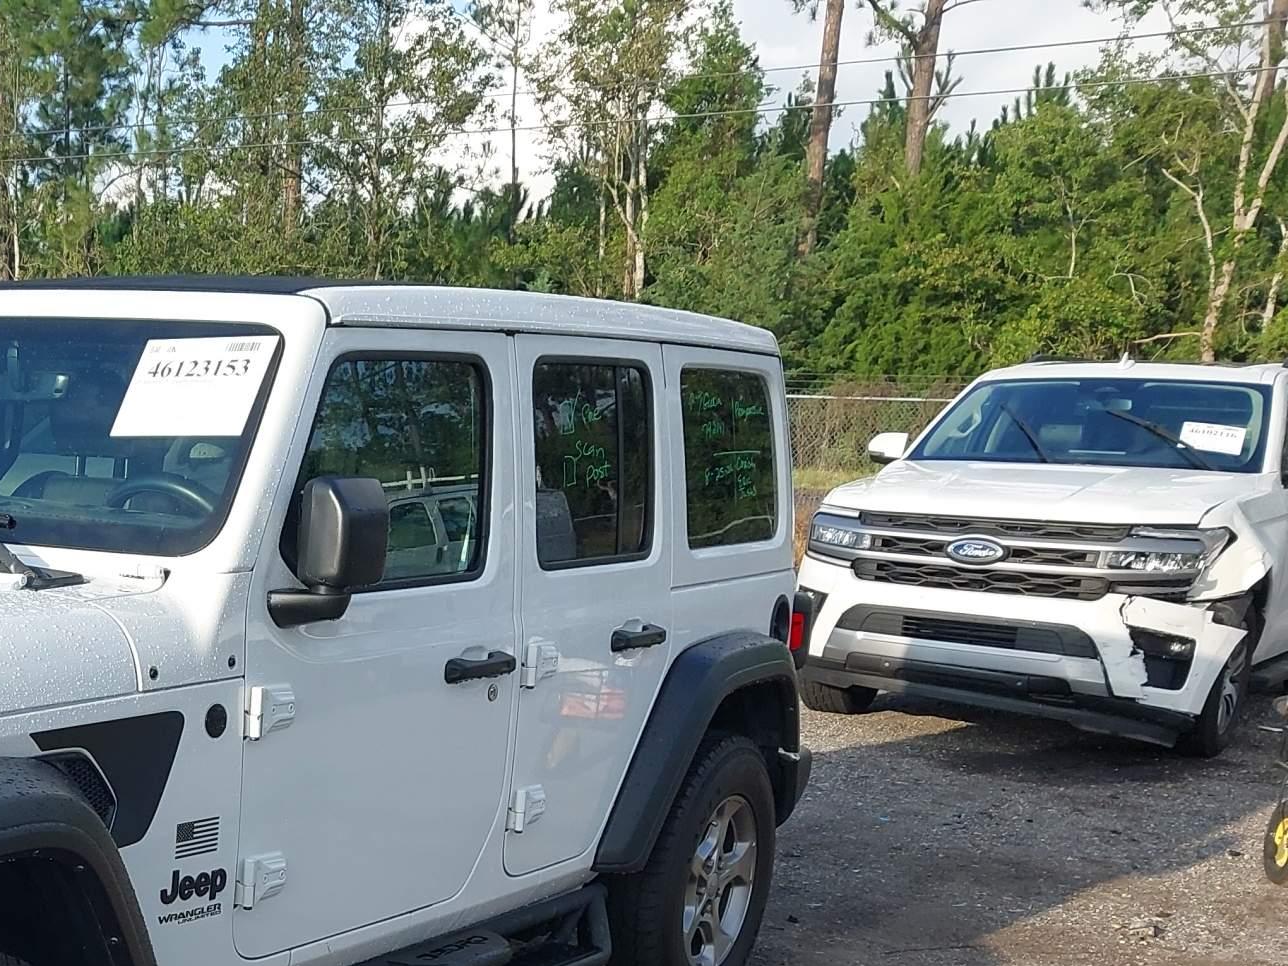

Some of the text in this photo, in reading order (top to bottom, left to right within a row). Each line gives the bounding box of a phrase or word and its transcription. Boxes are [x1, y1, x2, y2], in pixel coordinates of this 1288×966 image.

[148, 358, 251, 378] 46123153
[160, 868, 227, 905] Jeep
[158, 903, 222, 925] WRANGLER
